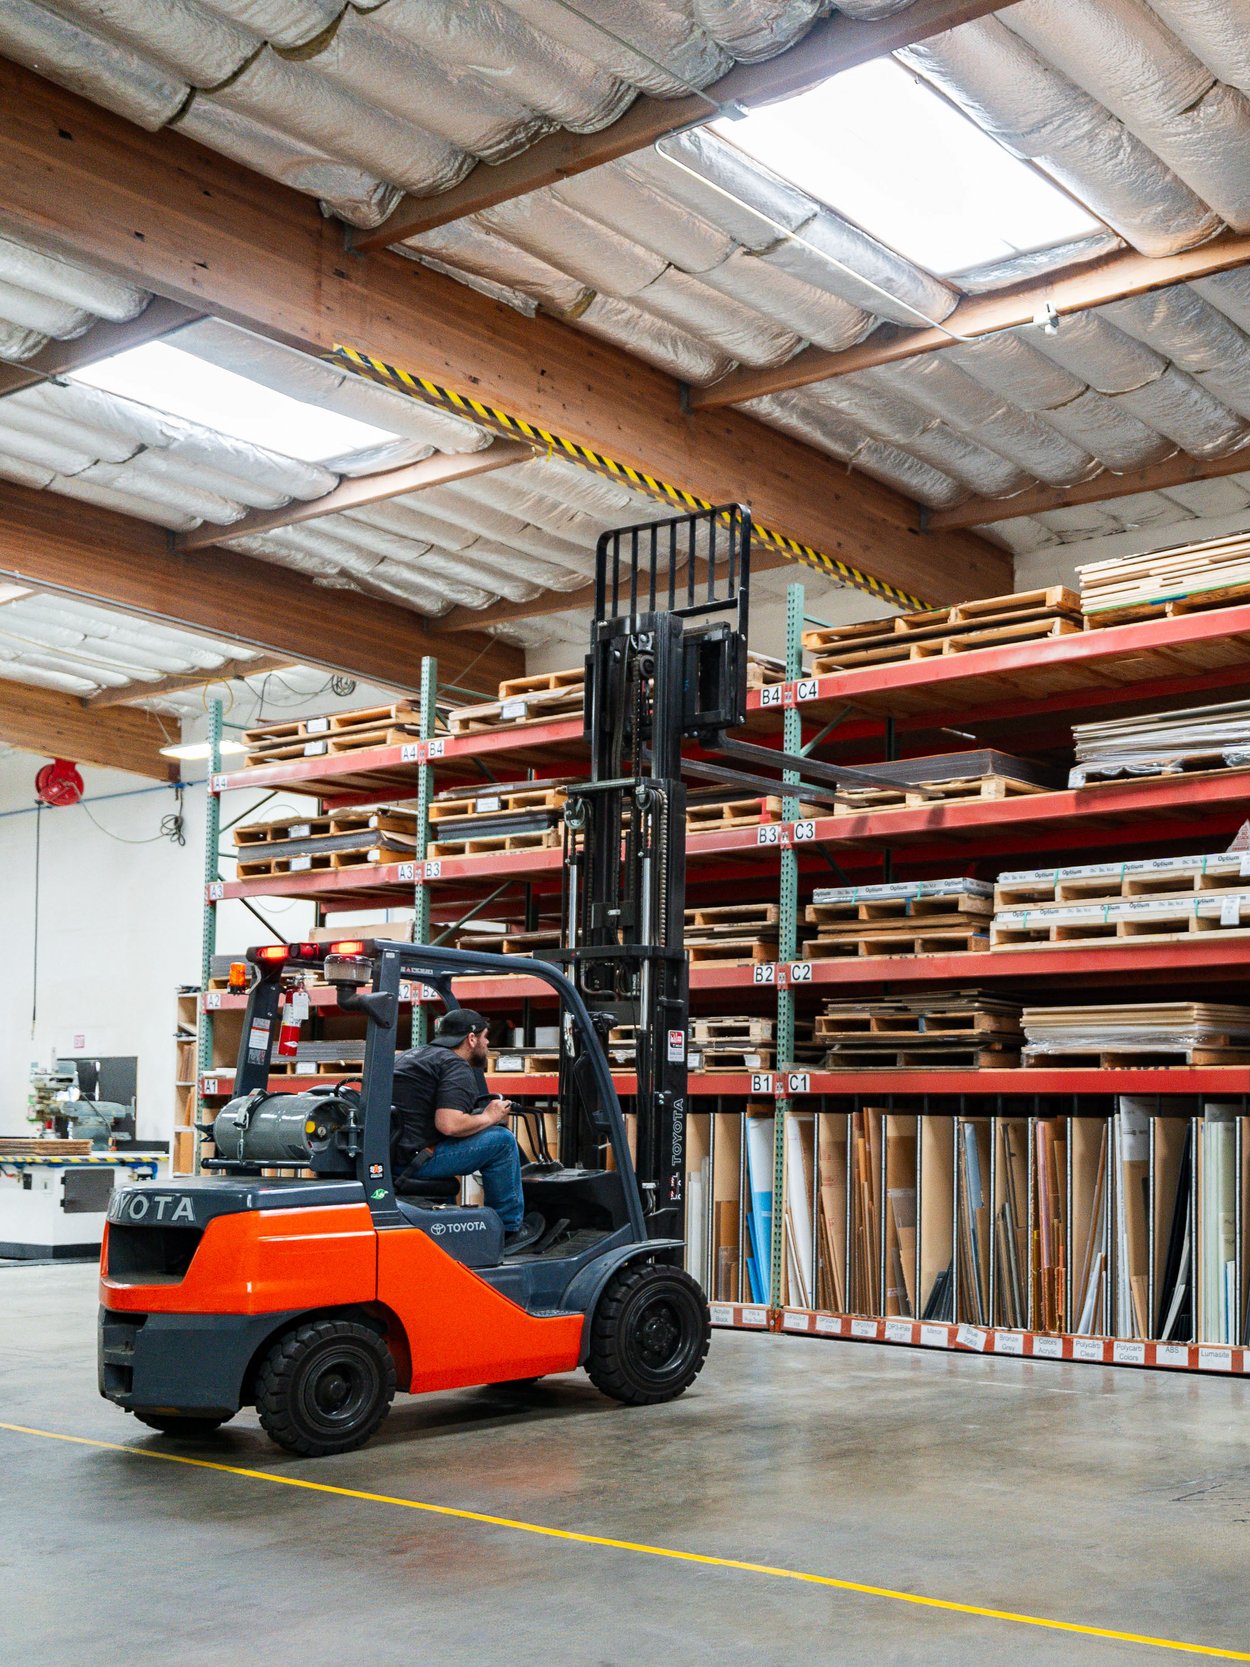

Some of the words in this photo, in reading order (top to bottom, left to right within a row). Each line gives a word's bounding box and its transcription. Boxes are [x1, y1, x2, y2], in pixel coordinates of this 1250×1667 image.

[762, 688, 781, 704] B4
[798, 682, 817, 699] C4
[402, 745, 416, 759] A4
[428, 743, 443, 756] B4
[214, 777, 227, 788] A4
[759, 827, 778, 843] B3
[795, 823, 814, 839] C3
[399, 865, 413, 879] A3
[425, 863, 440, 876] B3
[210, 885, 223, 898] A3
[755, 966, 773, 982] B2
[792, 965, 811, 981] C2
[207, 995, 220, 1007] A2
[204, 1080, 217, 1092] A1
[753, 1076, 771, 1091] B1
[789, 1075, 808, 1091] C1
[671, 1098, 683, 1166] TOYOTA
[447, 1221, 487, 1233] TOYOTA
[1038, 1337, 1057, 1346] Colors
[1075, 1340, 1100, 1349] Polycarb
[1116, 1343, 1142, 1353] Polycarb
[1038, 1346, 1057, 1355] Acrylic
[1080, 1350, 1096, 1358] Clear
[1165, 1346, 1180, 1354] ABS
[1201, 1350, 1230, 1359] Lumasite
[1119, 1353, 1139, 1361] Colors
